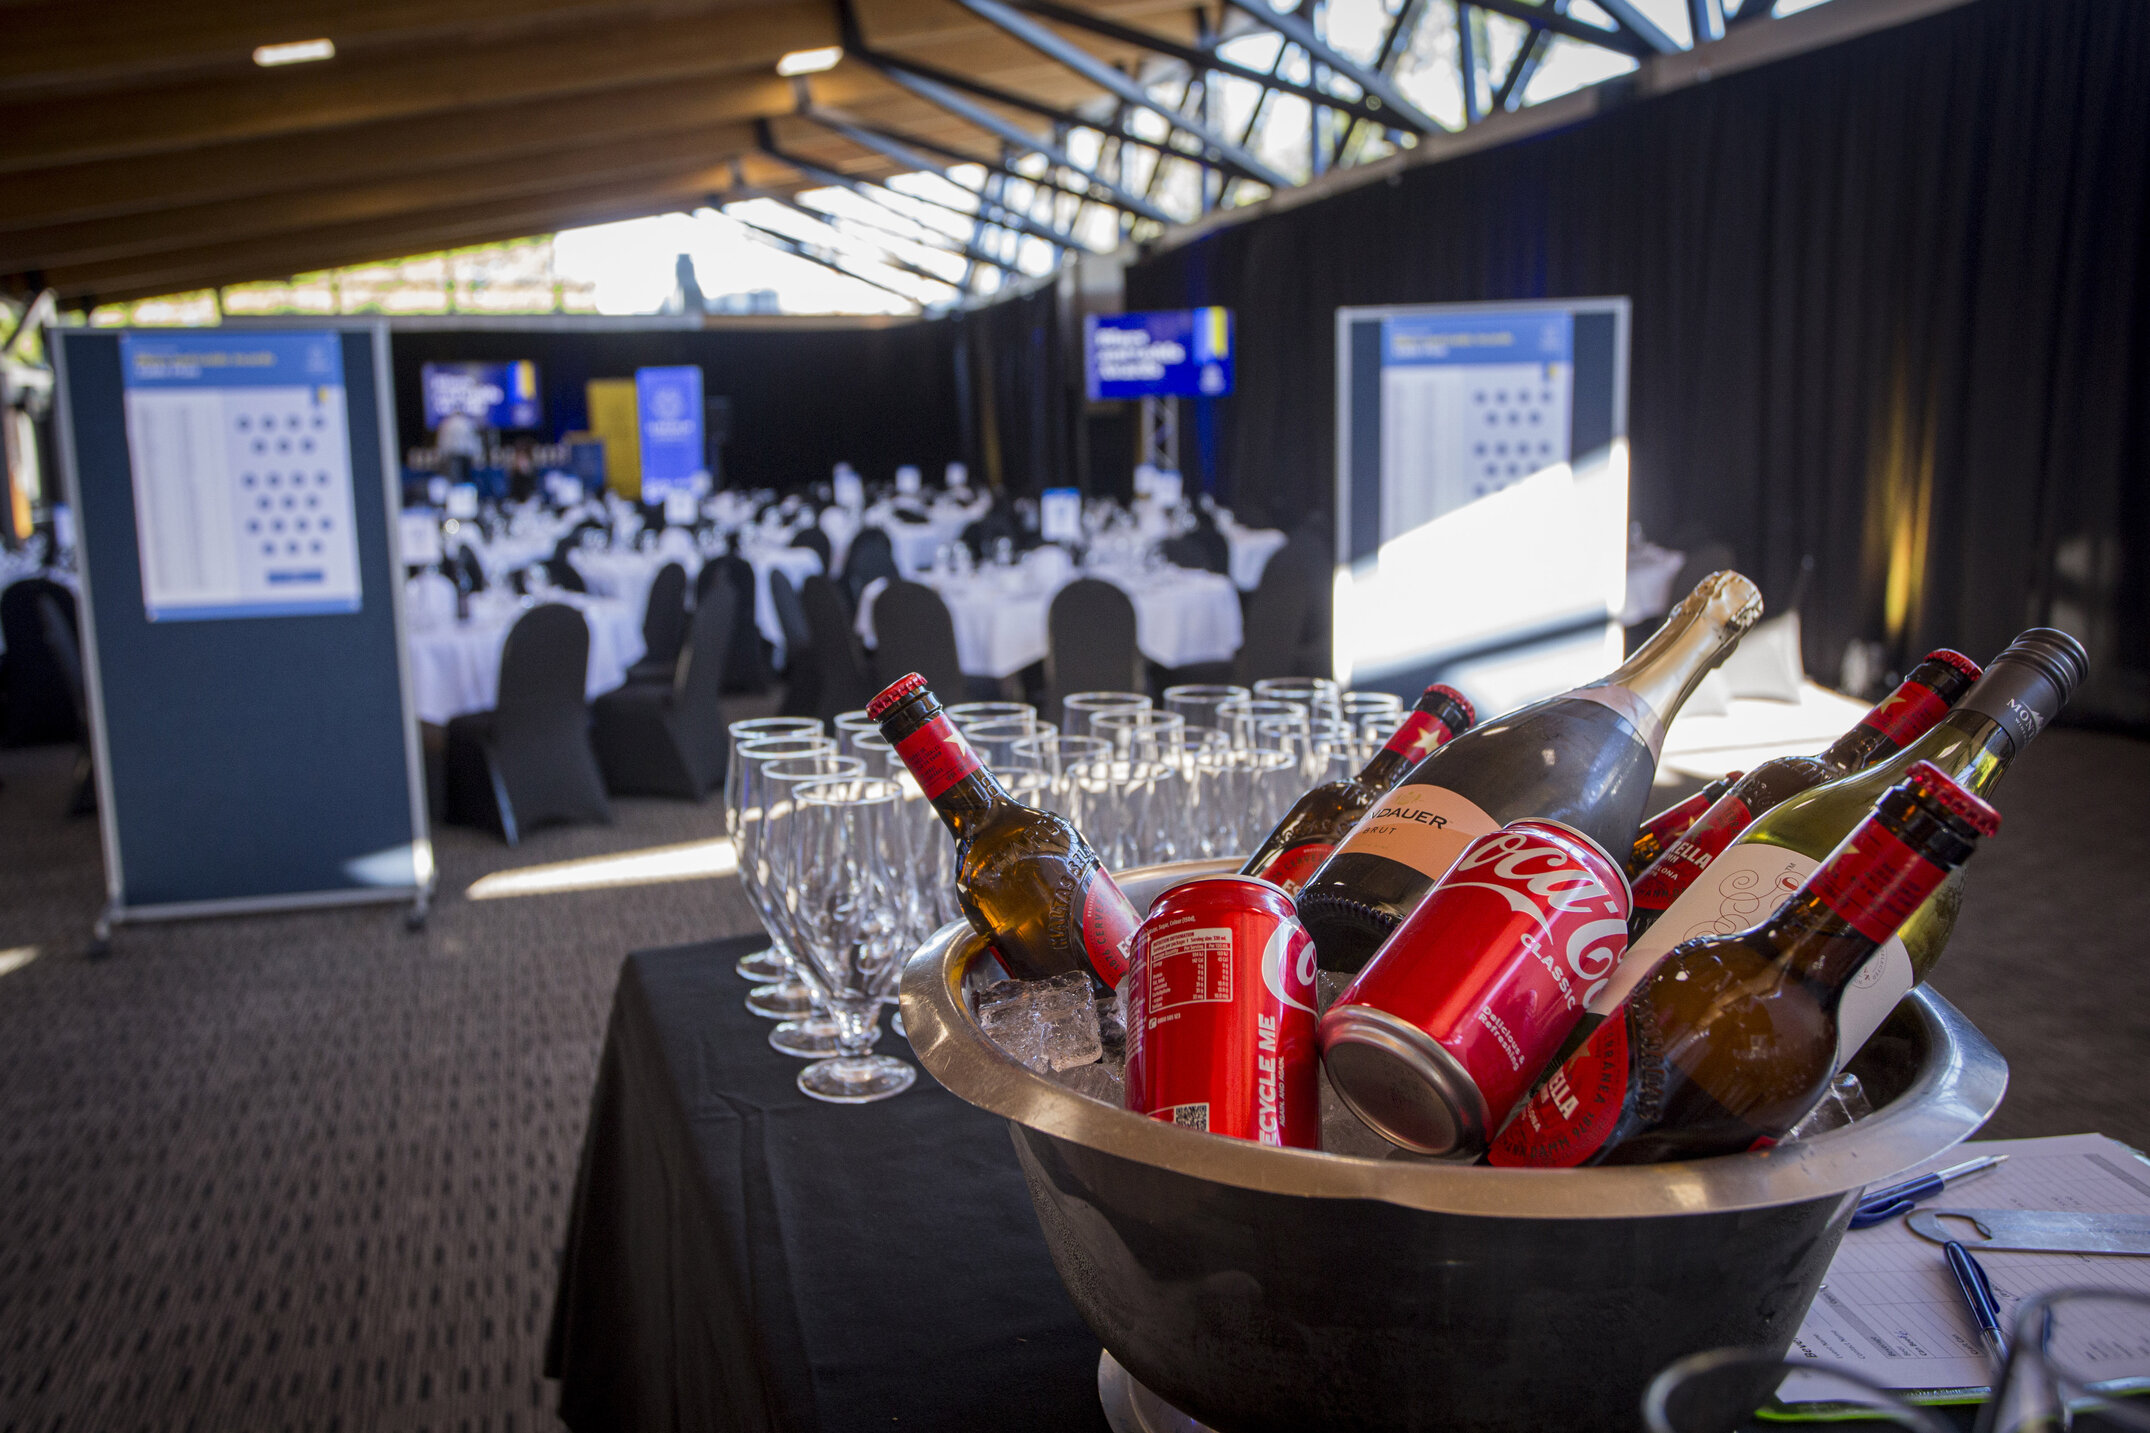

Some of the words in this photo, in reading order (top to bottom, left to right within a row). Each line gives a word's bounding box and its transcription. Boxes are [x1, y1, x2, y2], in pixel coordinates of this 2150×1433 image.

[1363, 826, 1396, 835] BRUT
[1370, 808, 1448, 829] NDAUER
[1672, 840, 1713, 870] ELLA
[1103, 950, 1120, 970] 1876
[1520, 933, 1576, 1011] CLASSIC
[1258, 1013, 1276, 1052] ME
[1478, 1013, 1519, 1072] Refreshing
[1482, 1005, 1520, 1054] Delicious
[1519, 1055, 1526, 1065] &
[1258, 1054, 1277, 1146] ECYCLE
